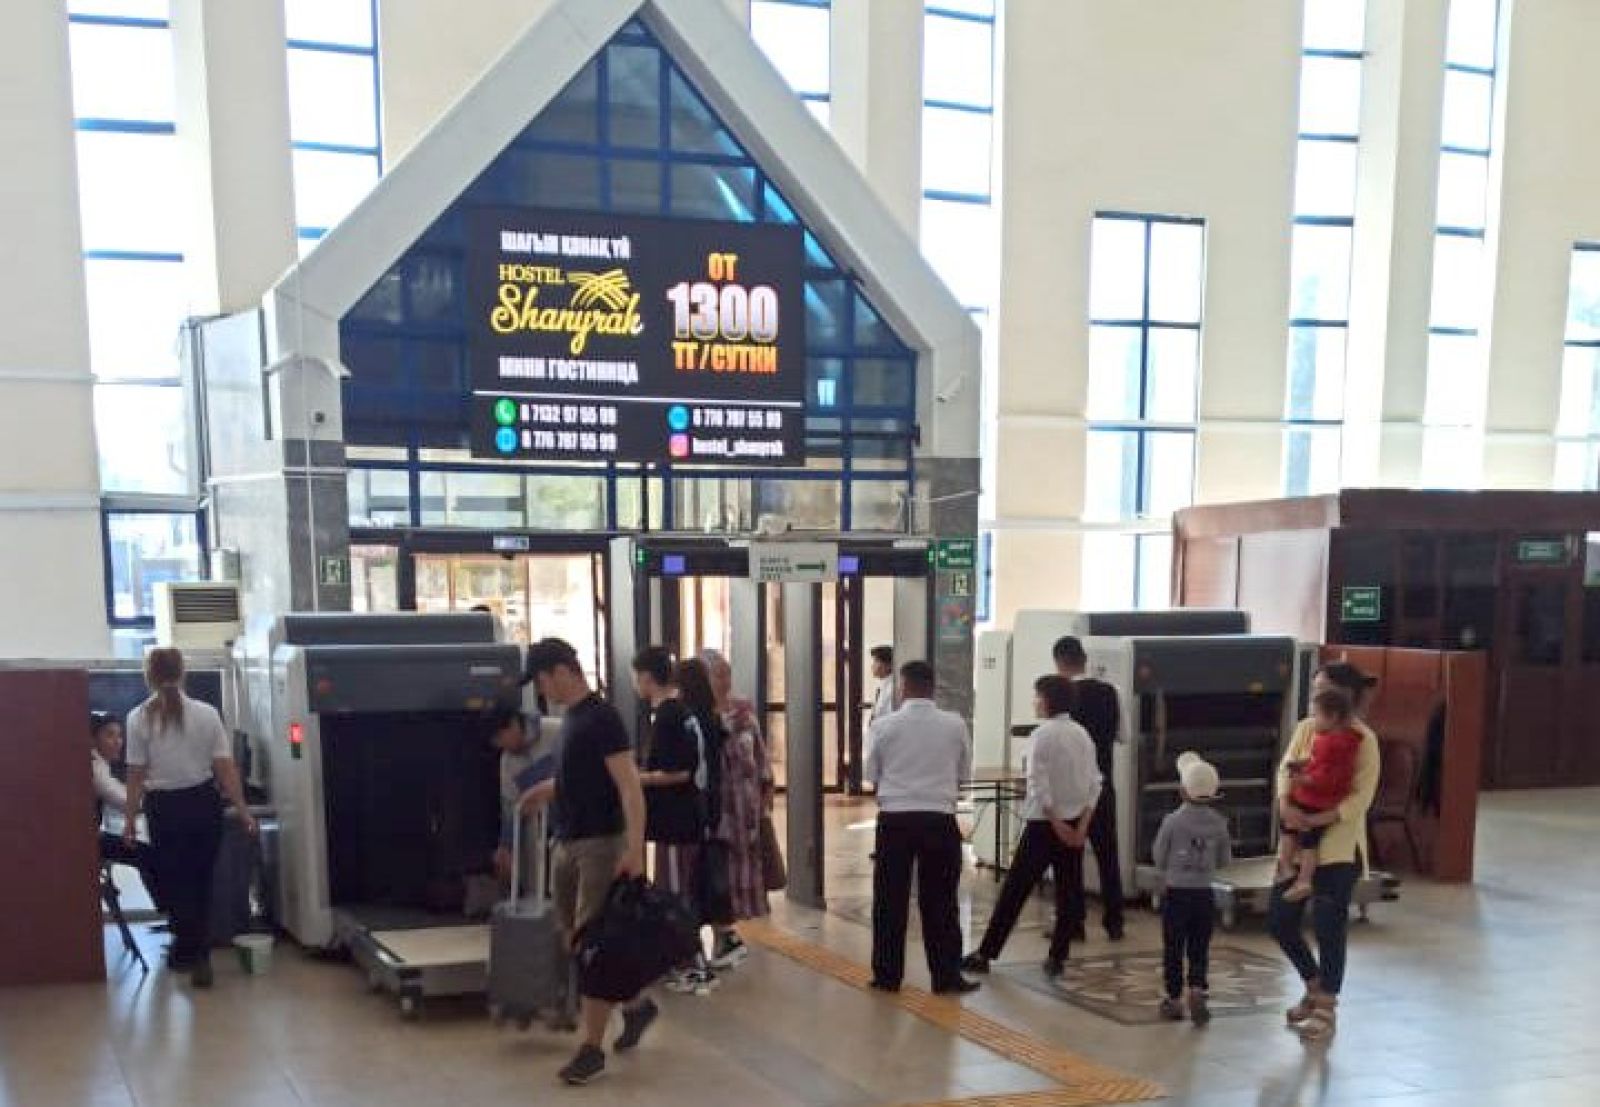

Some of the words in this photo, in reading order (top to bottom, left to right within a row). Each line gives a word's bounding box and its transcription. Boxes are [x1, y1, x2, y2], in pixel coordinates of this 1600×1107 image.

[499, 263, 566, 285] HOSTEL
[708, 252, 738, 281] ОТ
[490, 284, 645, 355] Shanyrak
[667, 281, 779, 343] 1300
[548, 358, 639, 386] ГОСТИНИЦА
